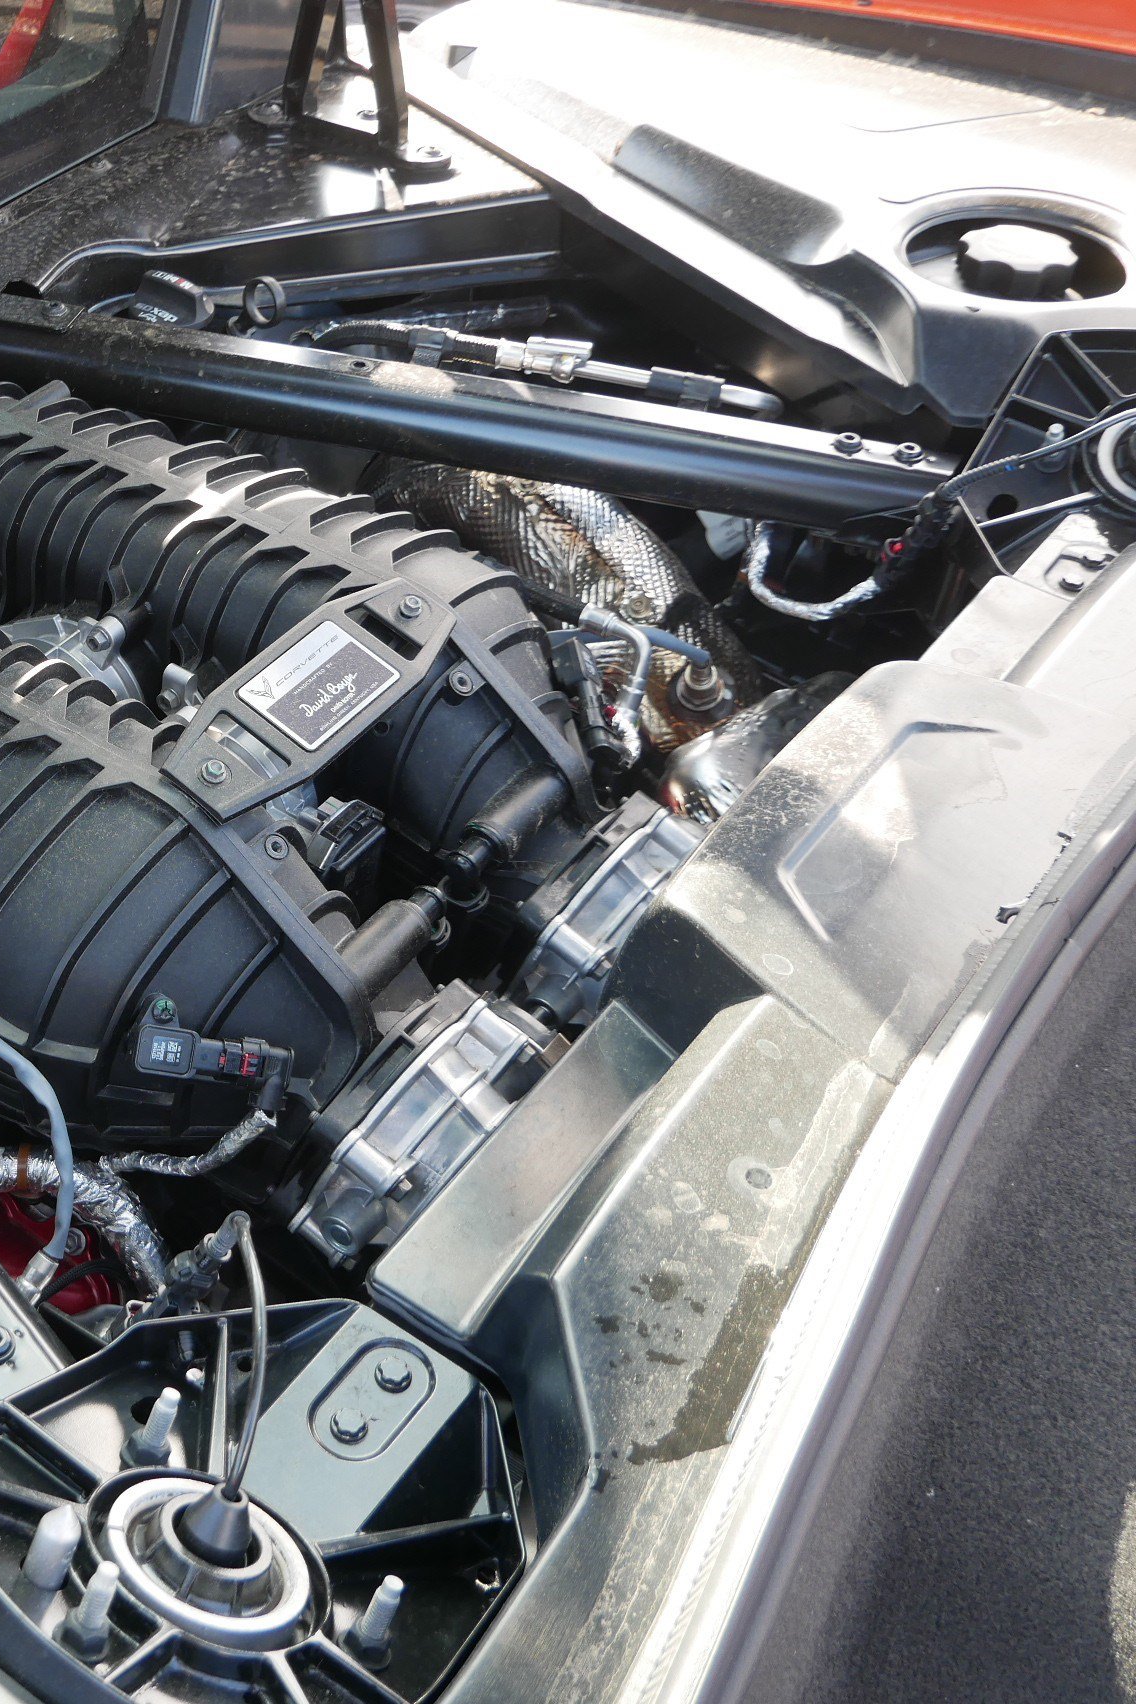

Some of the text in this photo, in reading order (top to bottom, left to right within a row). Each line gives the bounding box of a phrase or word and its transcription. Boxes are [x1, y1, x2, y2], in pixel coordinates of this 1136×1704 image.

[276, 634, 339, 687] CORVETTE
[293, 668, 325, 694] HANDCRAFTED
[299, 688, 334, 717] David
